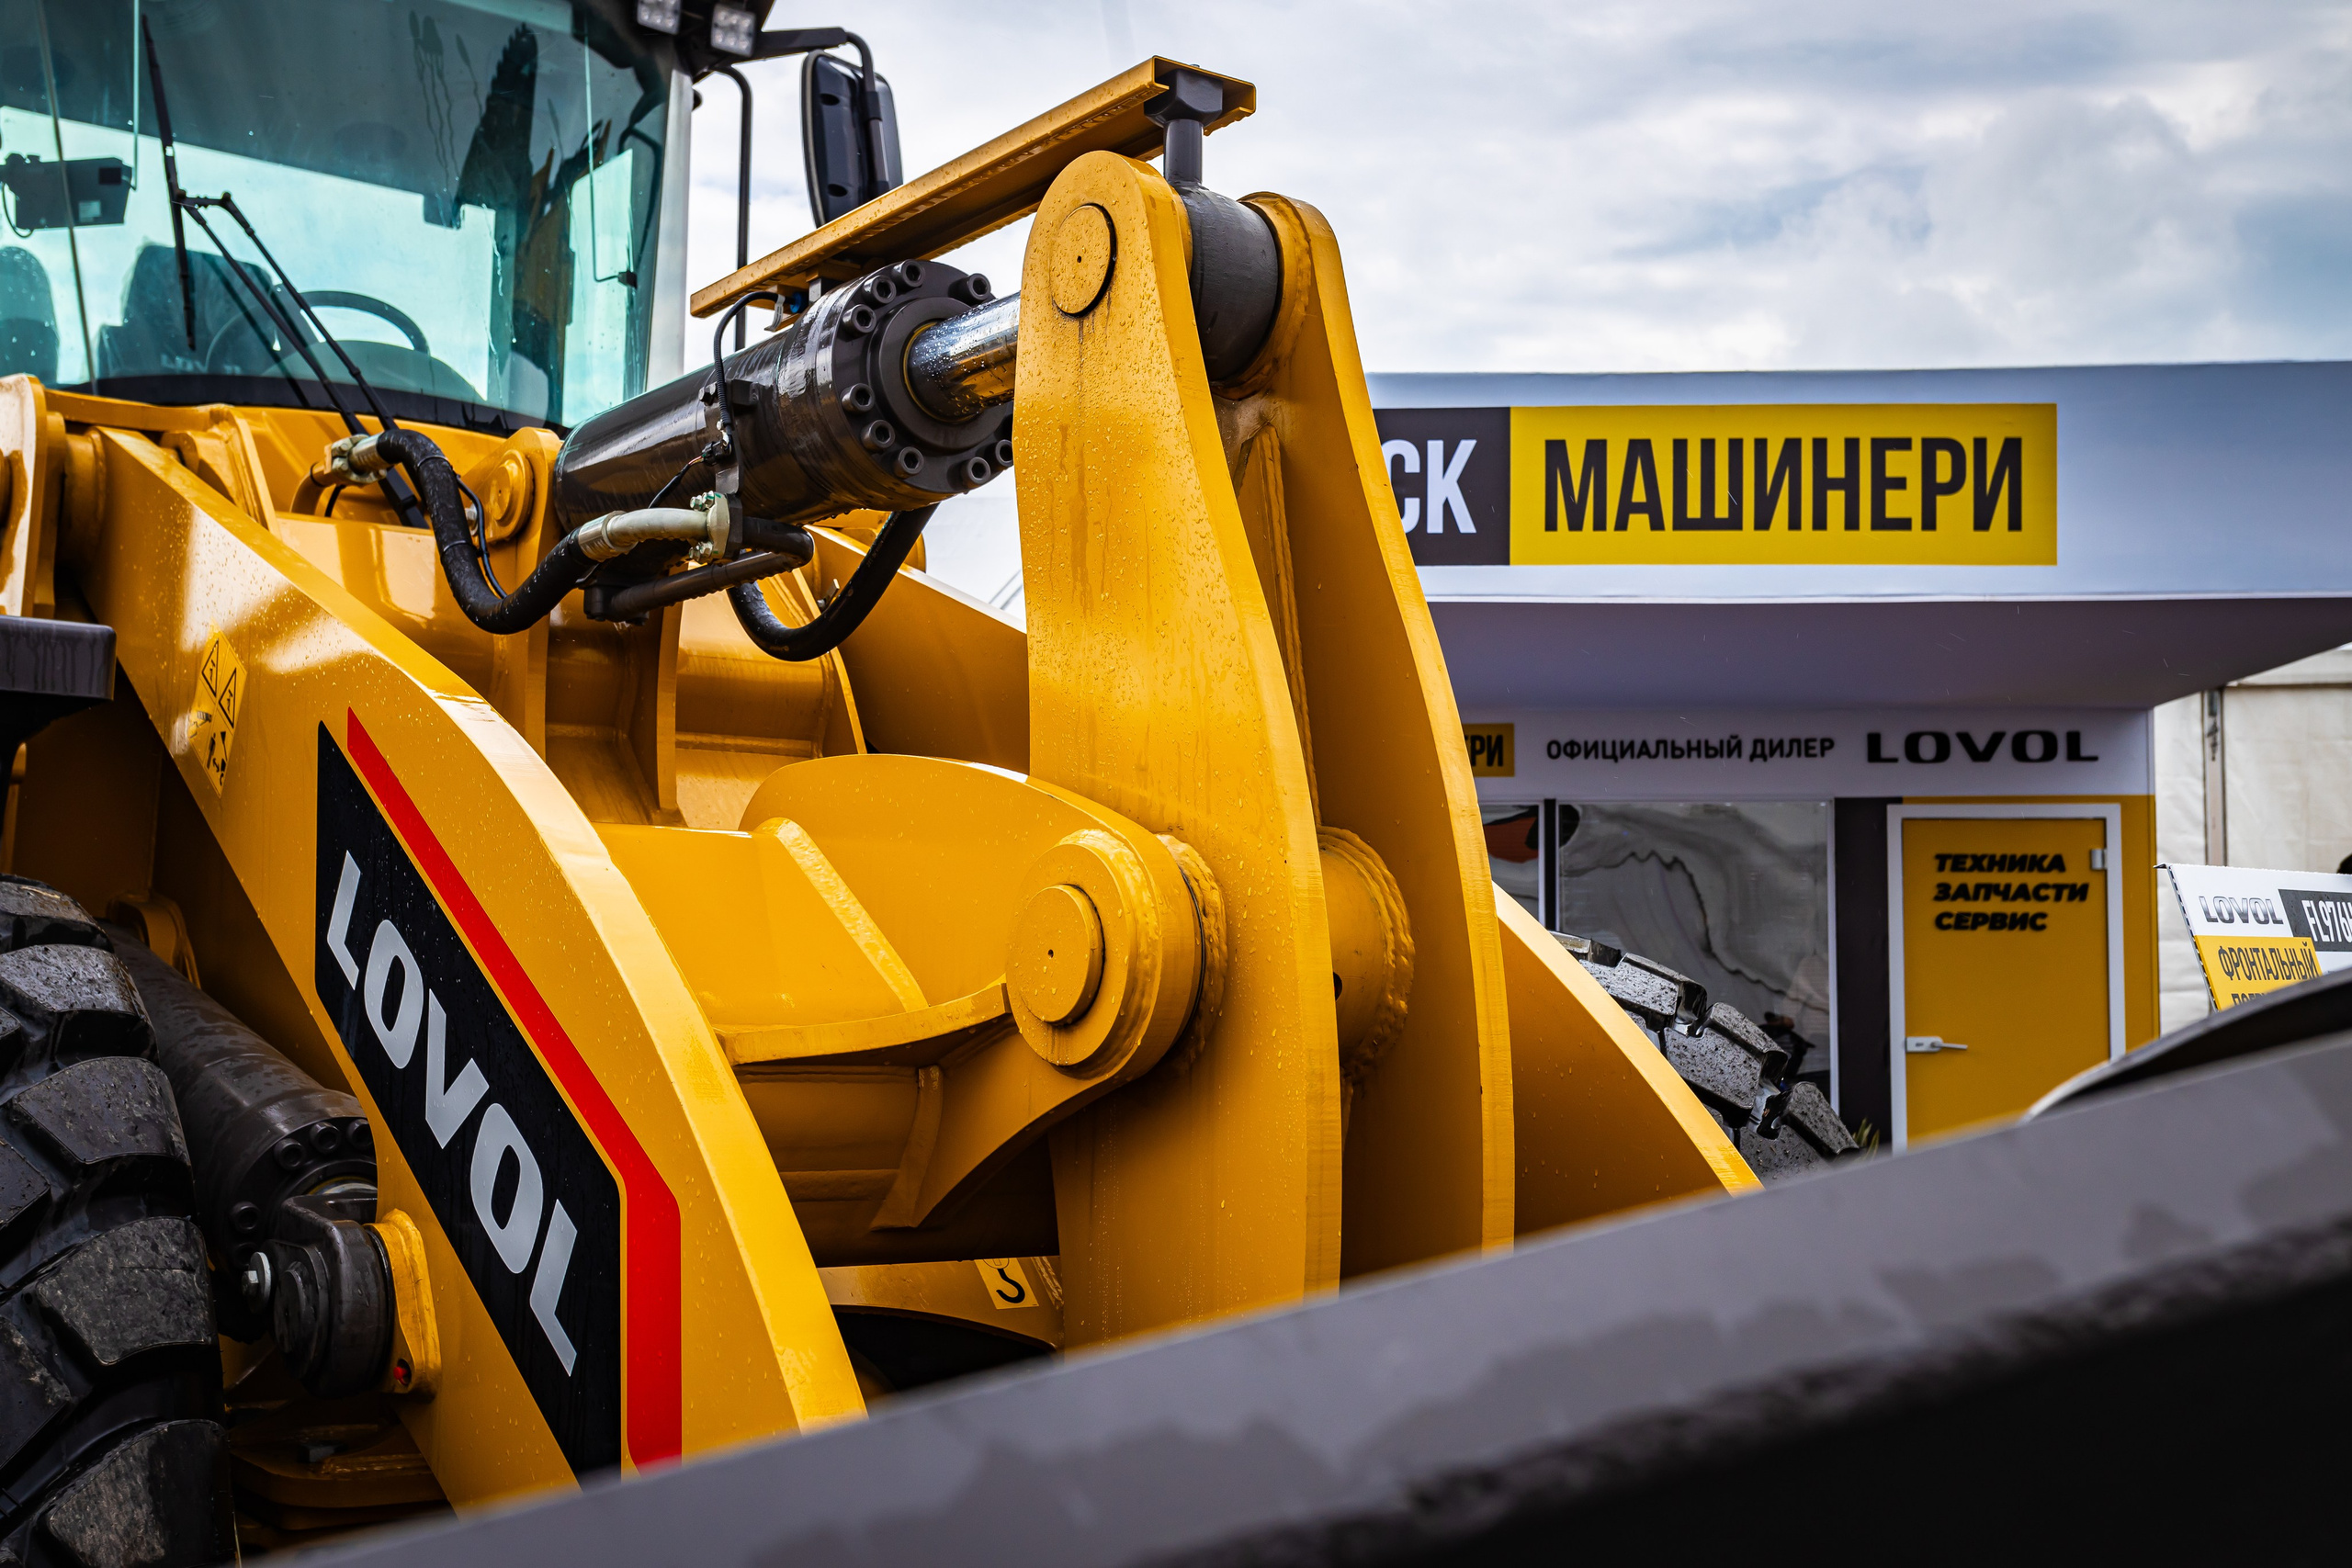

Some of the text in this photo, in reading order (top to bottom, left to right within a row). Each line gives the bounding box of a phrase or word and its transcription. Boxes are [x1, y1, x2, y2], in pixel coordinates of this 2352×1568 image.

[1544, 437, 2023, 532] МАШИНЕРИ
[1464, 734, 1504, 768] РИ
[1546, 730, 2099, 763] ОФИЦИАЛЬНЫЙ ДИЛЕР LOVOL
[1934, 853, 2066, 873] ТЕХНИКА
[1933, 883, 2089, 902] ЗАПЧАСТИ
[1935, 912, 2048, 931] СЕРВИС
[2199, 896, 2284, 925] LOVOL
[2218, 942, 2321, 981] ФРОНТАЛЬНЫЙ
[326, 851, 578, 1377] LOVOL
